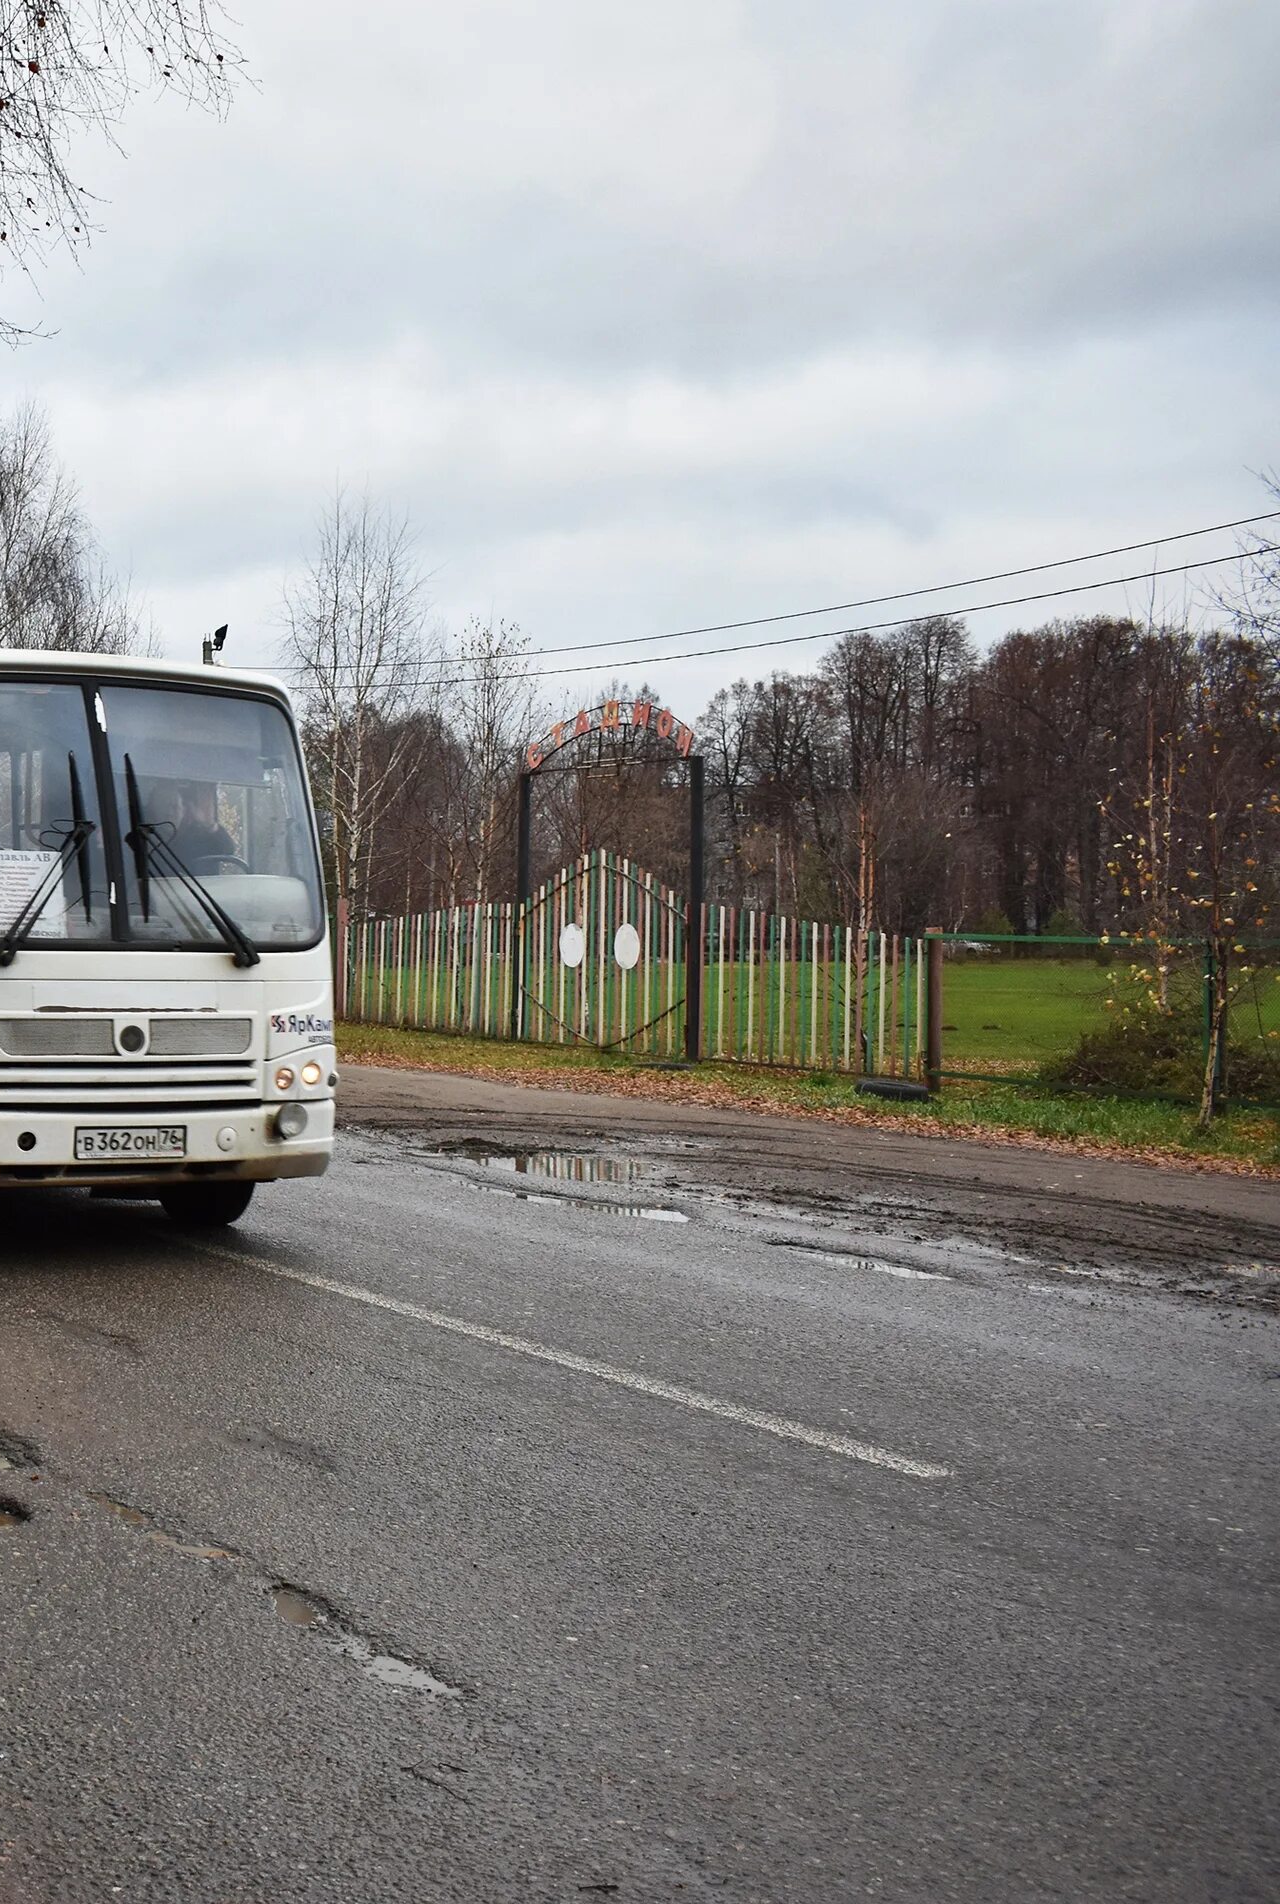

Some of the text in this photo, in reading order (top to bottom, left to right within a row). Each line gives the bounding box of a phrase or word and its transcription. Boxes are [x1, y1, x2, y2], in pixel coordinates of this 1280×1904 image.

[526, 699, 695, 769] СТАДИОН
[34, 853, 51, 862] АВ
[83, 1130, 178, 1151] В362ОН 76
